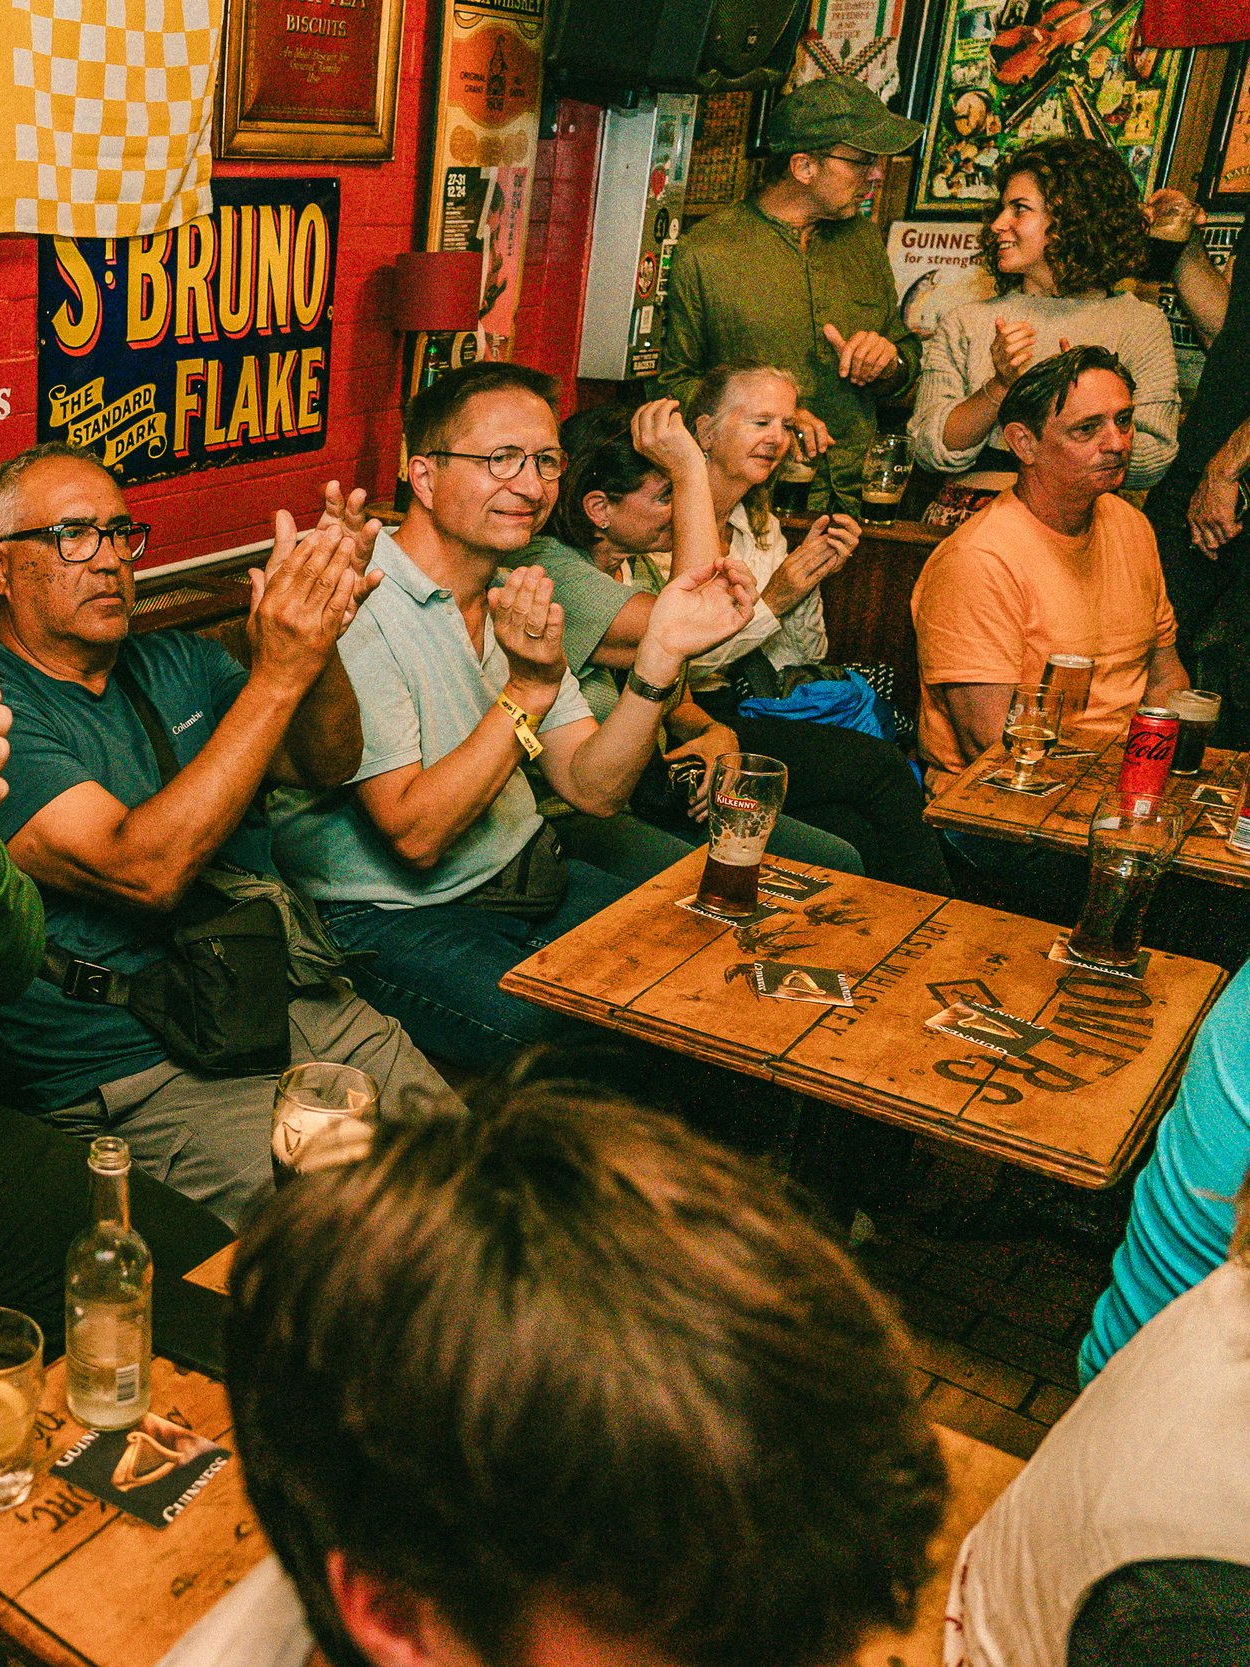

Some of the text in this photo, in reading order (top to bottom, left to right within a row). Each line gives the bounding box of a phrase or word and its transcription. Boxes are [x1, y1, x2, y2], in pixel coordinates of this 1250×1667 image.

[286, 14, 347, 37] BISCUITS
[901, 228, 983, 250] GUINNES
[126, 203, 330, 349] BRUNO
[904, 252, 923, 264] for
[59, 385, 94, 419] THE
[72, 386, 152, 446] STANDARD
[174, 346, 324, 457] FLAKE
[114, 419, 158, 458] DARK
[1125, 731, 1177, 761] Cola
[716, 793, 757, 810] KILKENNY
[894, 920, 953, 960] IRISH
[931, 976, 1154, 1106] OWERS
[933, 1024, 1008, 1055] GUINNESS
[162, 1456, 228, 1523] GUINNESS
